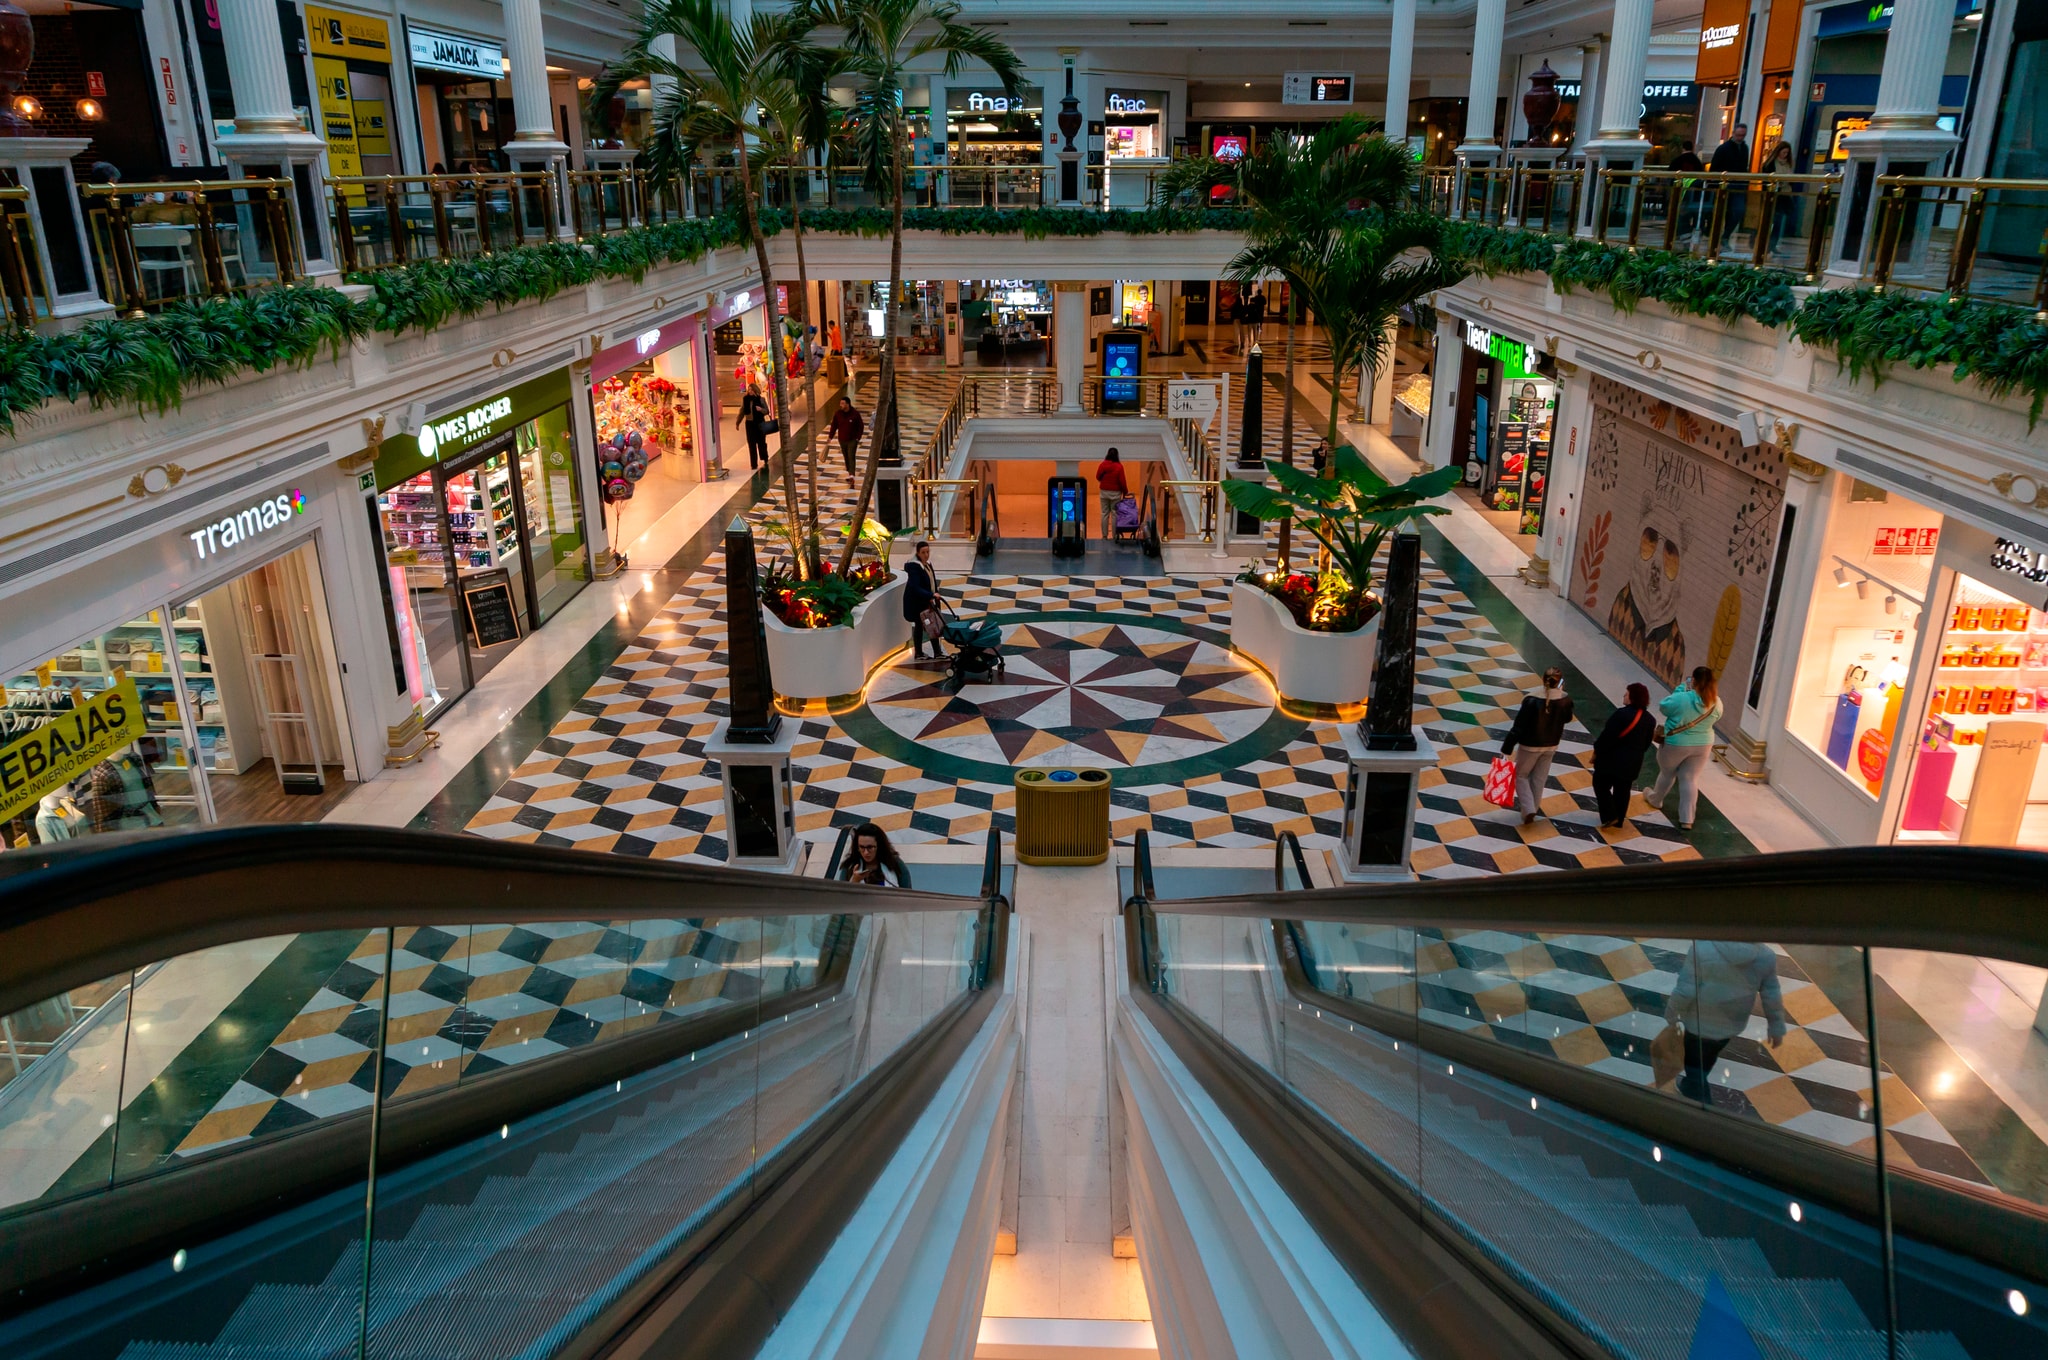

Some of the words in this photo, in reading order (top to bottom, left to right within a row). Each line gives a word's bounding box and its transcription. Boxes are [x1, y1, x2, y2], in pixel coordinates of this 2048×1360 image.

[433, 41, 479, 67] JAMAICA
[1109, 93, 1146, 112] fnac
[1643, 86, 1689, 97] OFFEE
[329, 143, 356, 154] BOUTIQUE
[341, 160, 350, 169] DE
[1466, 321, 1524, 369] Tiendanimal
[435, 416, 467, 445] YVES
[467, 396, 512, 432] ROCHER
[463, 426, 491, 445] FRANCE
[1643, 441, 1704, 496] FASHION
[190, 494, 292, 559] Tramas
[0, 693, 126, 798] EBAJAS
[29, 758, 75, 793] INVIERNO
[76, 739, 108, 765] DESDE
[107, 725, 130, 746] 7,99€
